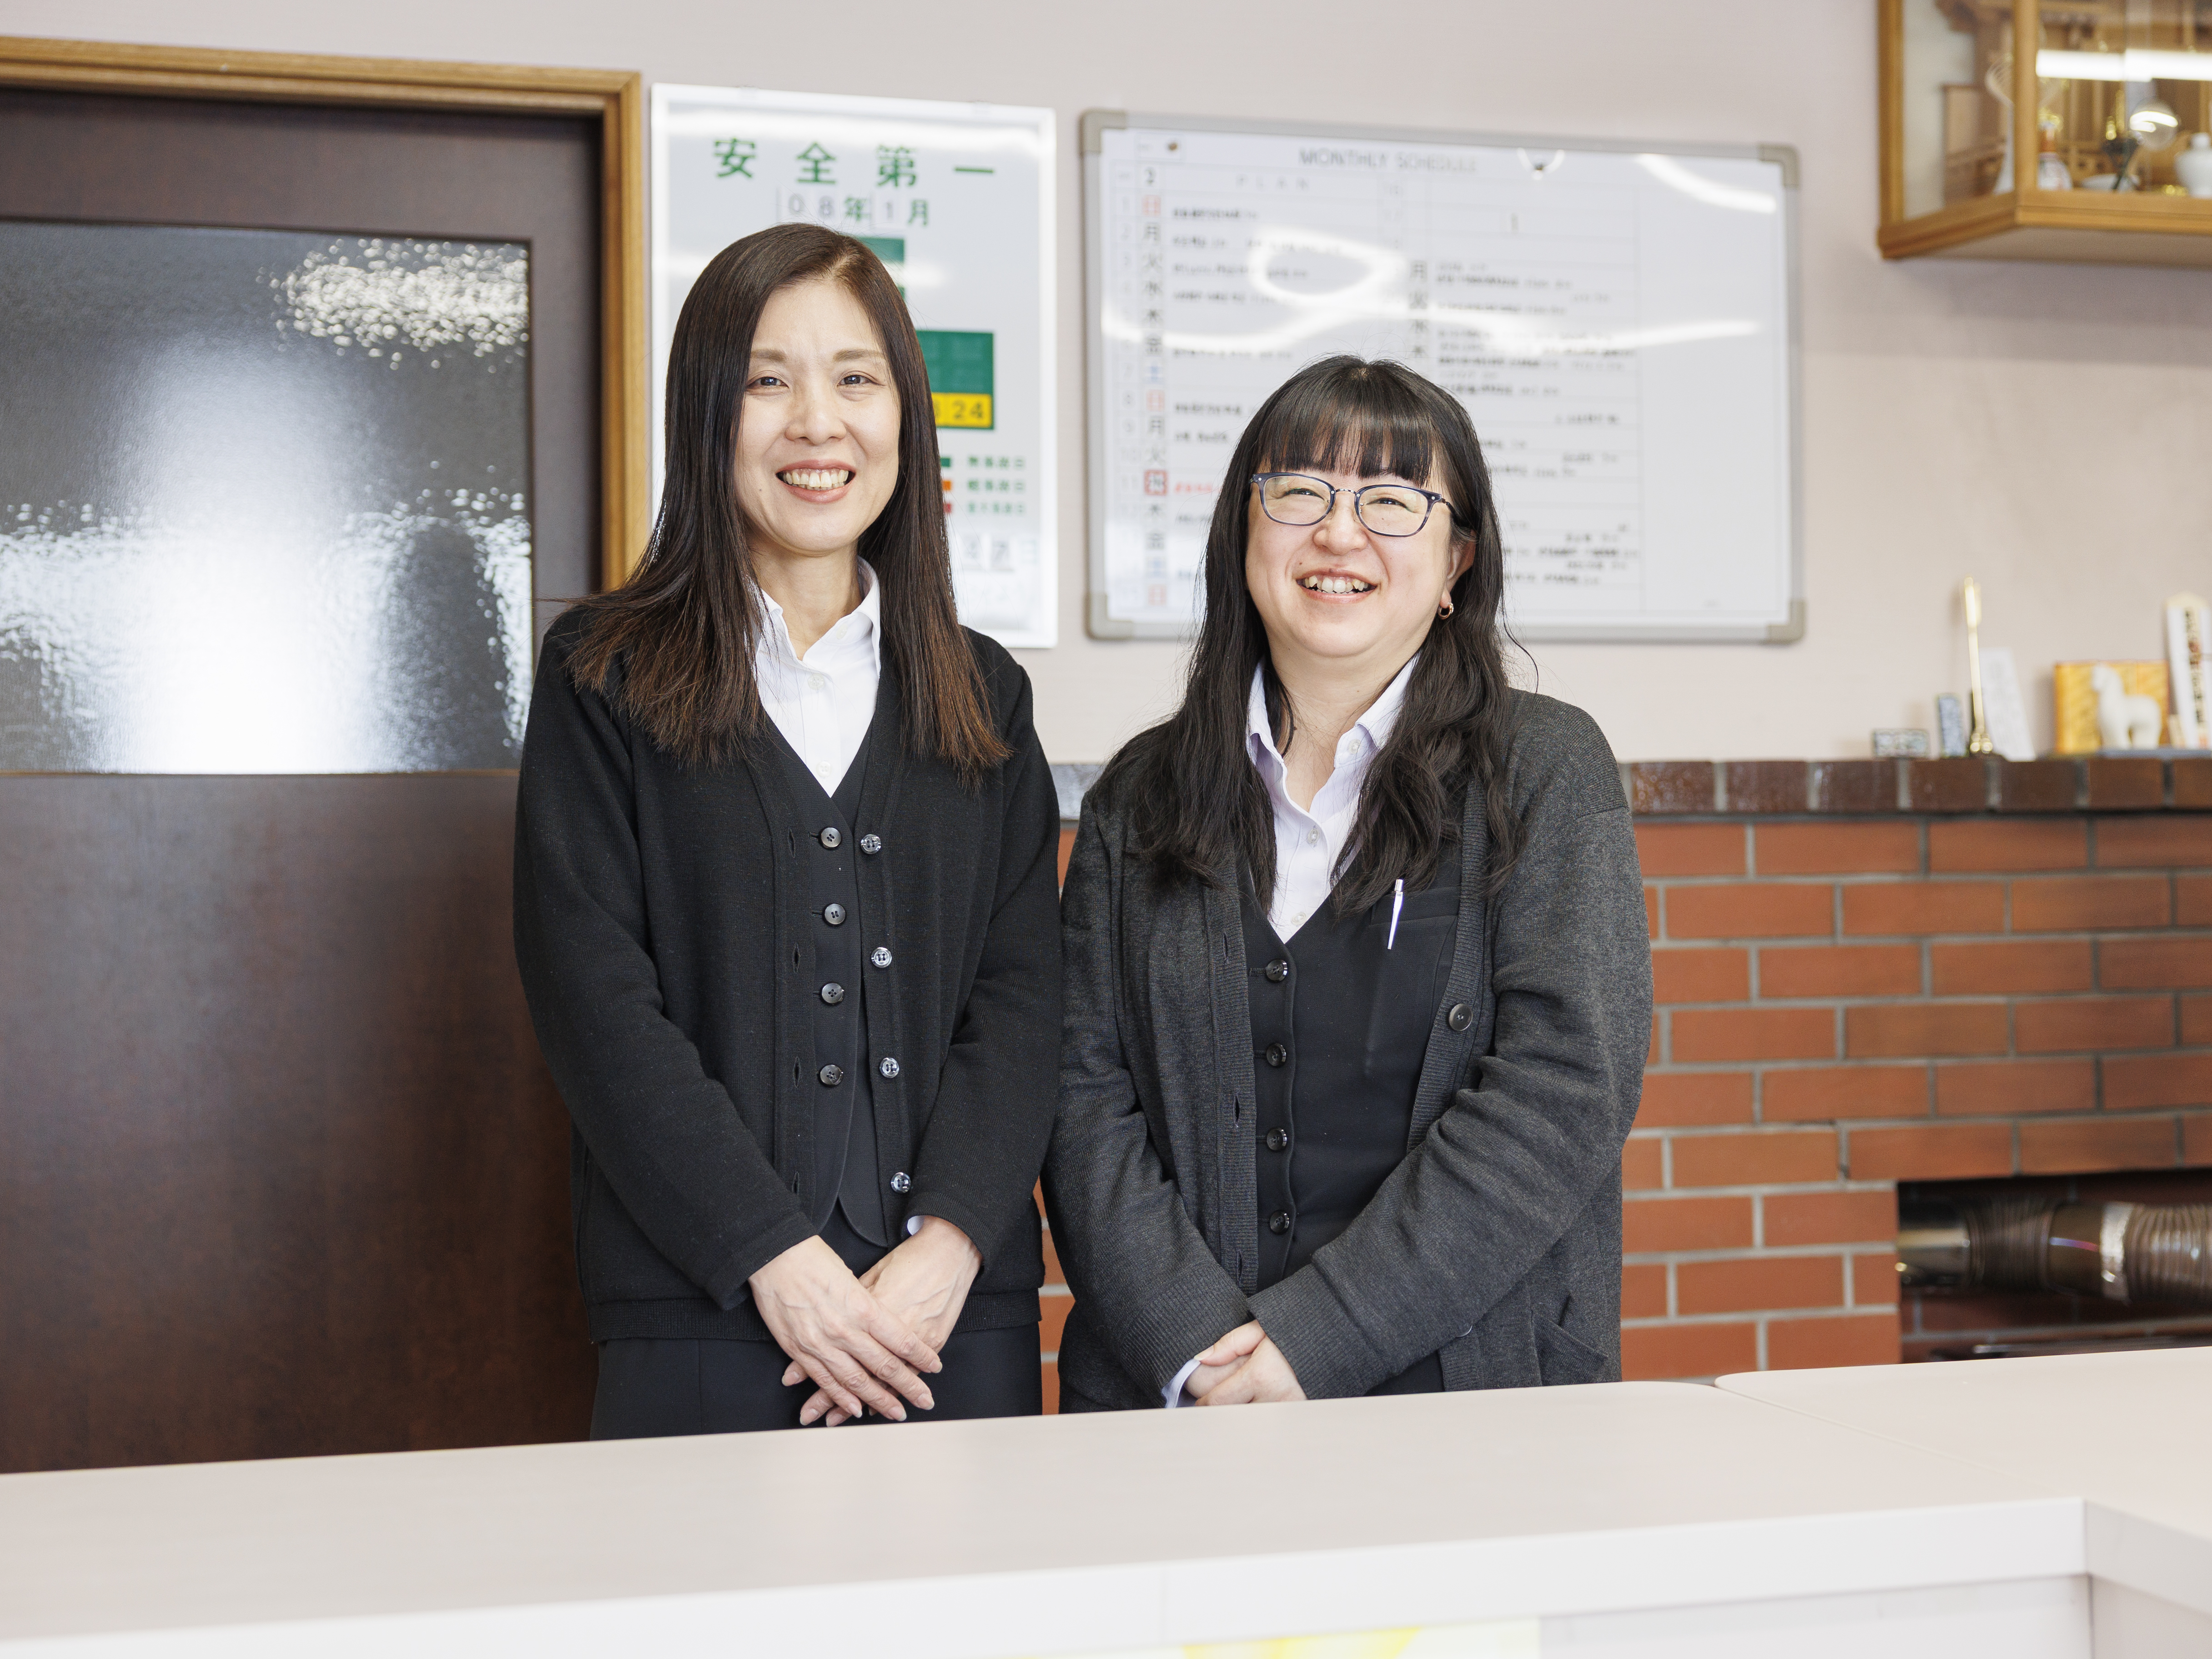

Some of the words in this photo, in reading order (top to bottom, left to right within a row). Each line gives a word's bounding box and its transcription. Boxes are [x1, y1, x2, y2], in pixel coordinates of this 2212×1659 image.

[714, 137, 995, 187] 安全第一
[1142, 221, 1161, 245] 月
[1141, 251, 1163, 273] 火
[1409, 259, 1428, 283] 月
[1146, 415, 1165, 438] 月
